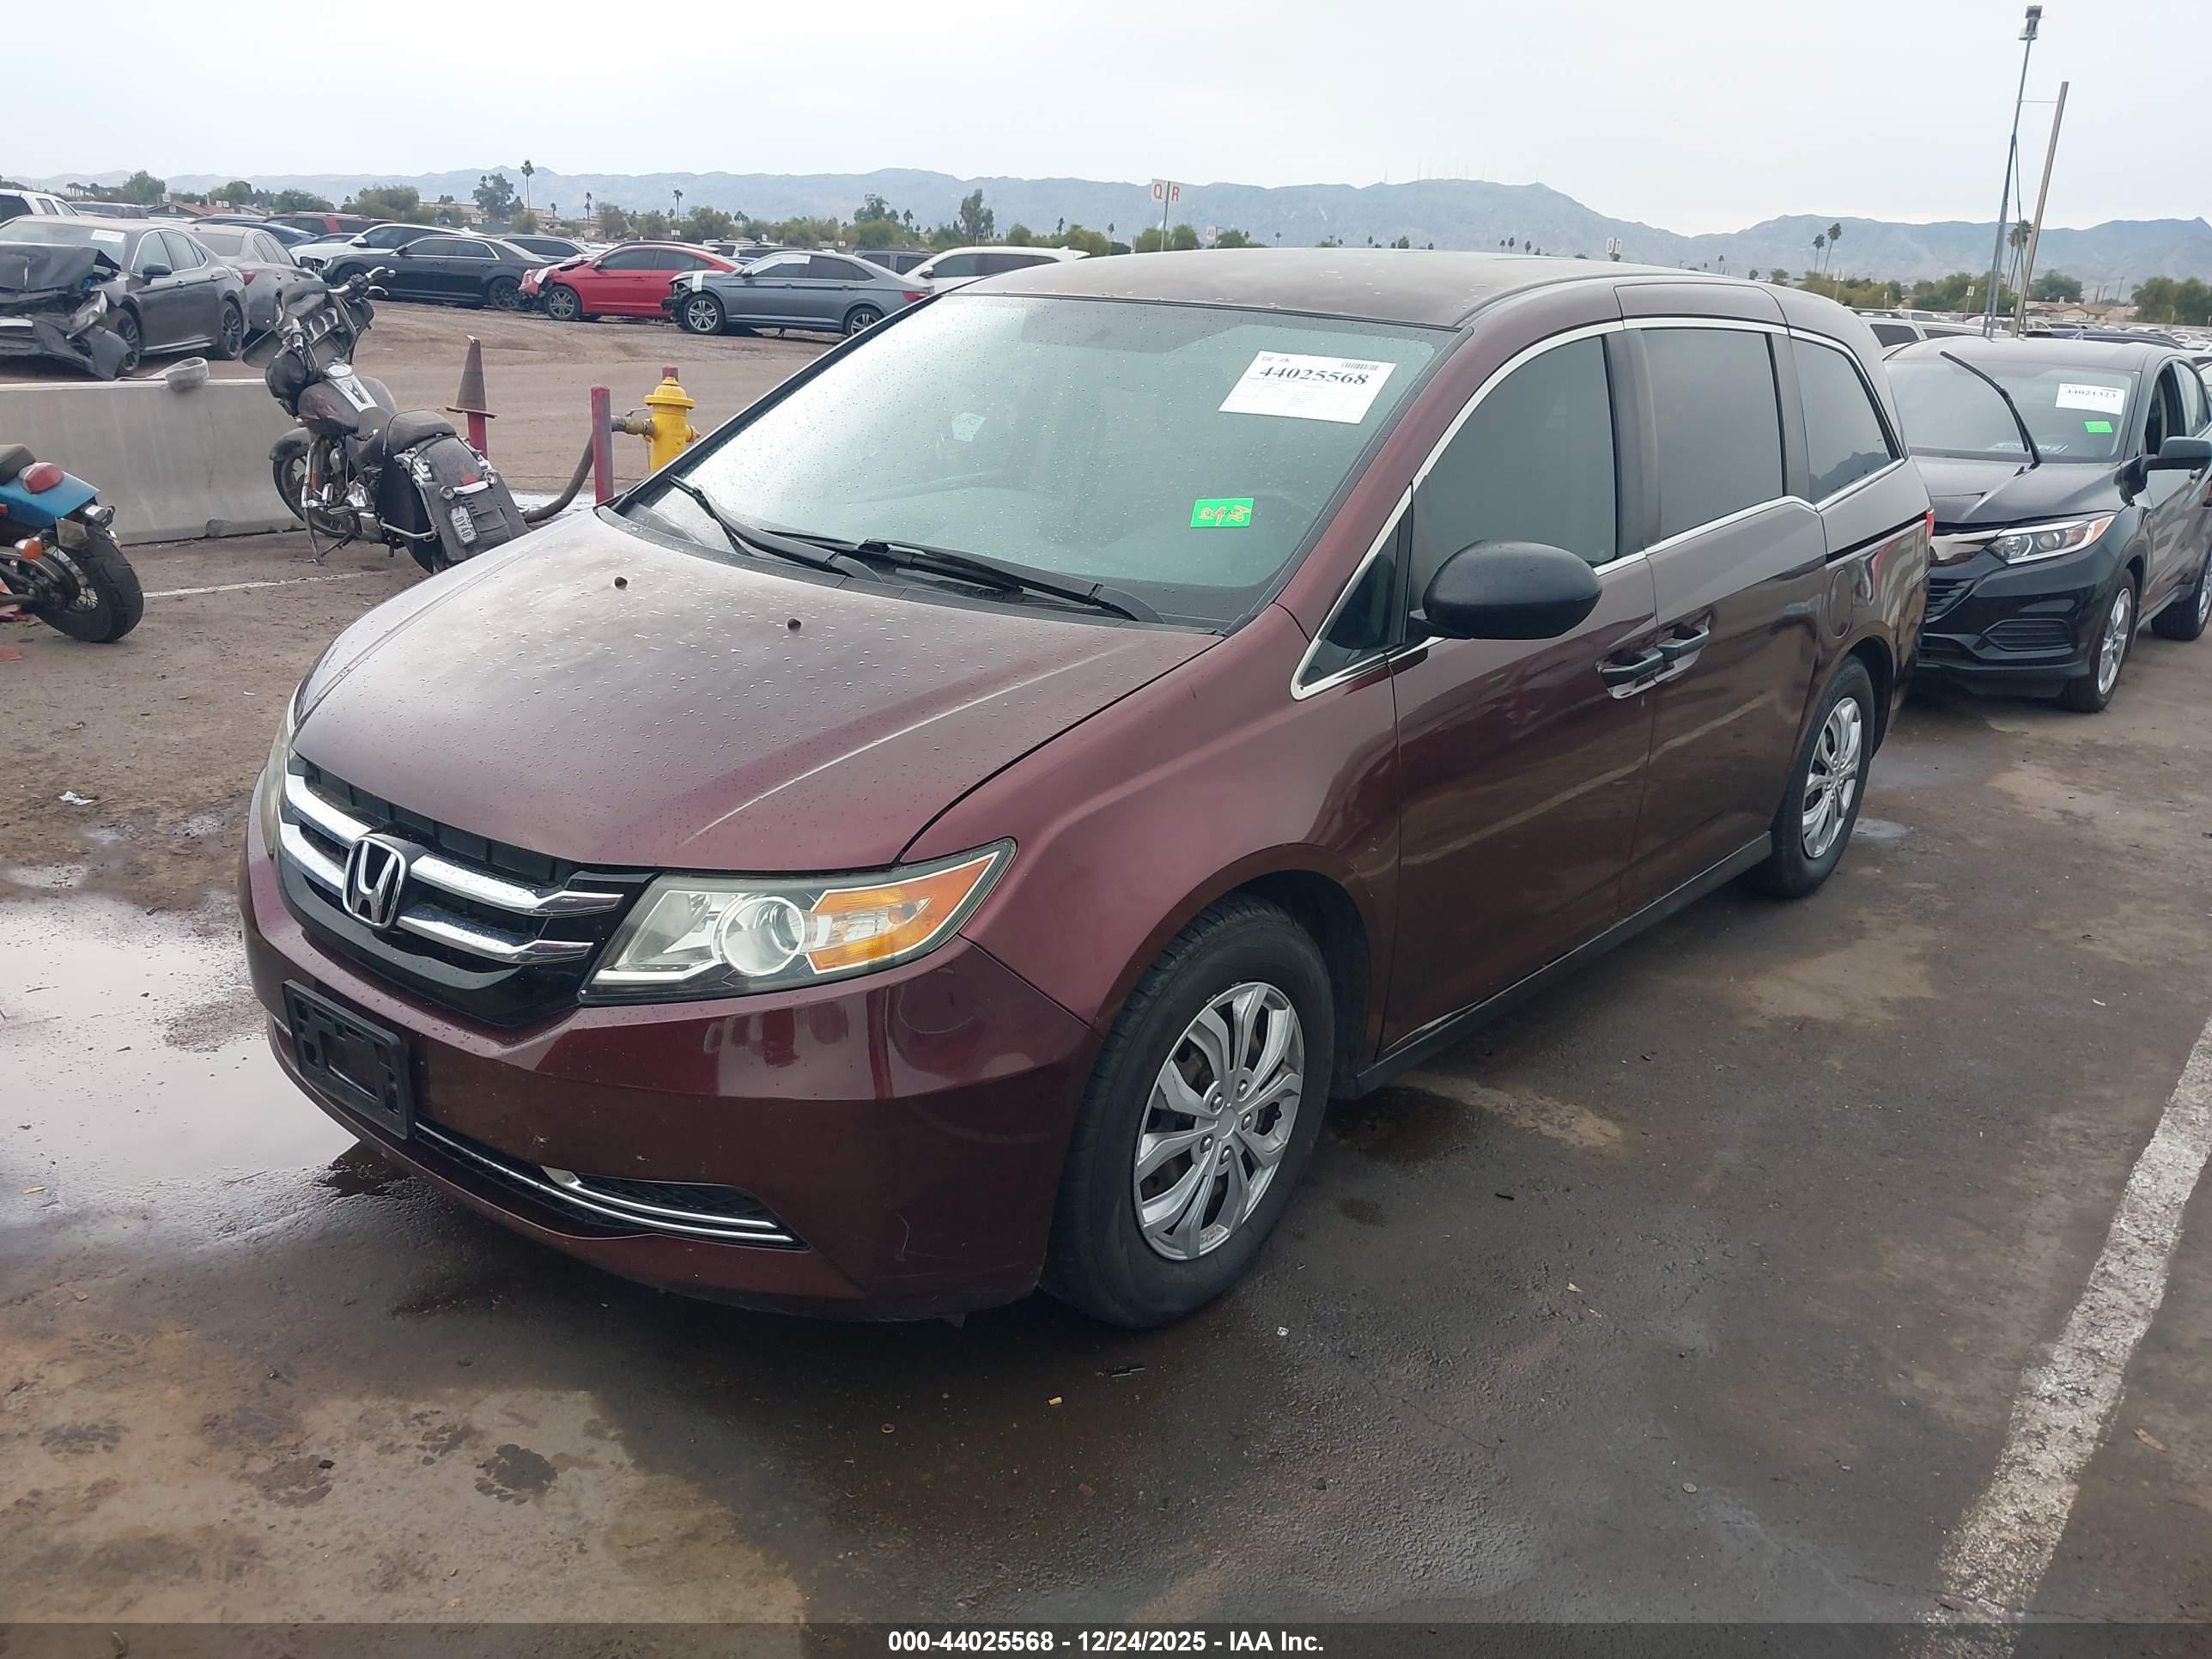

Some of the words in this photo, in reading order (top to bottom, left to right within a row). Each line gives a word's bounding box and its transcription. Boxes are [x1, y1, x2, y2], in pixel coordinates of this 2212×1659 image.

[1154, 184, 1163, 200] Q
[1171, 186, 1180, 202] R
[1259, 366, 1370, 386] 44025568
